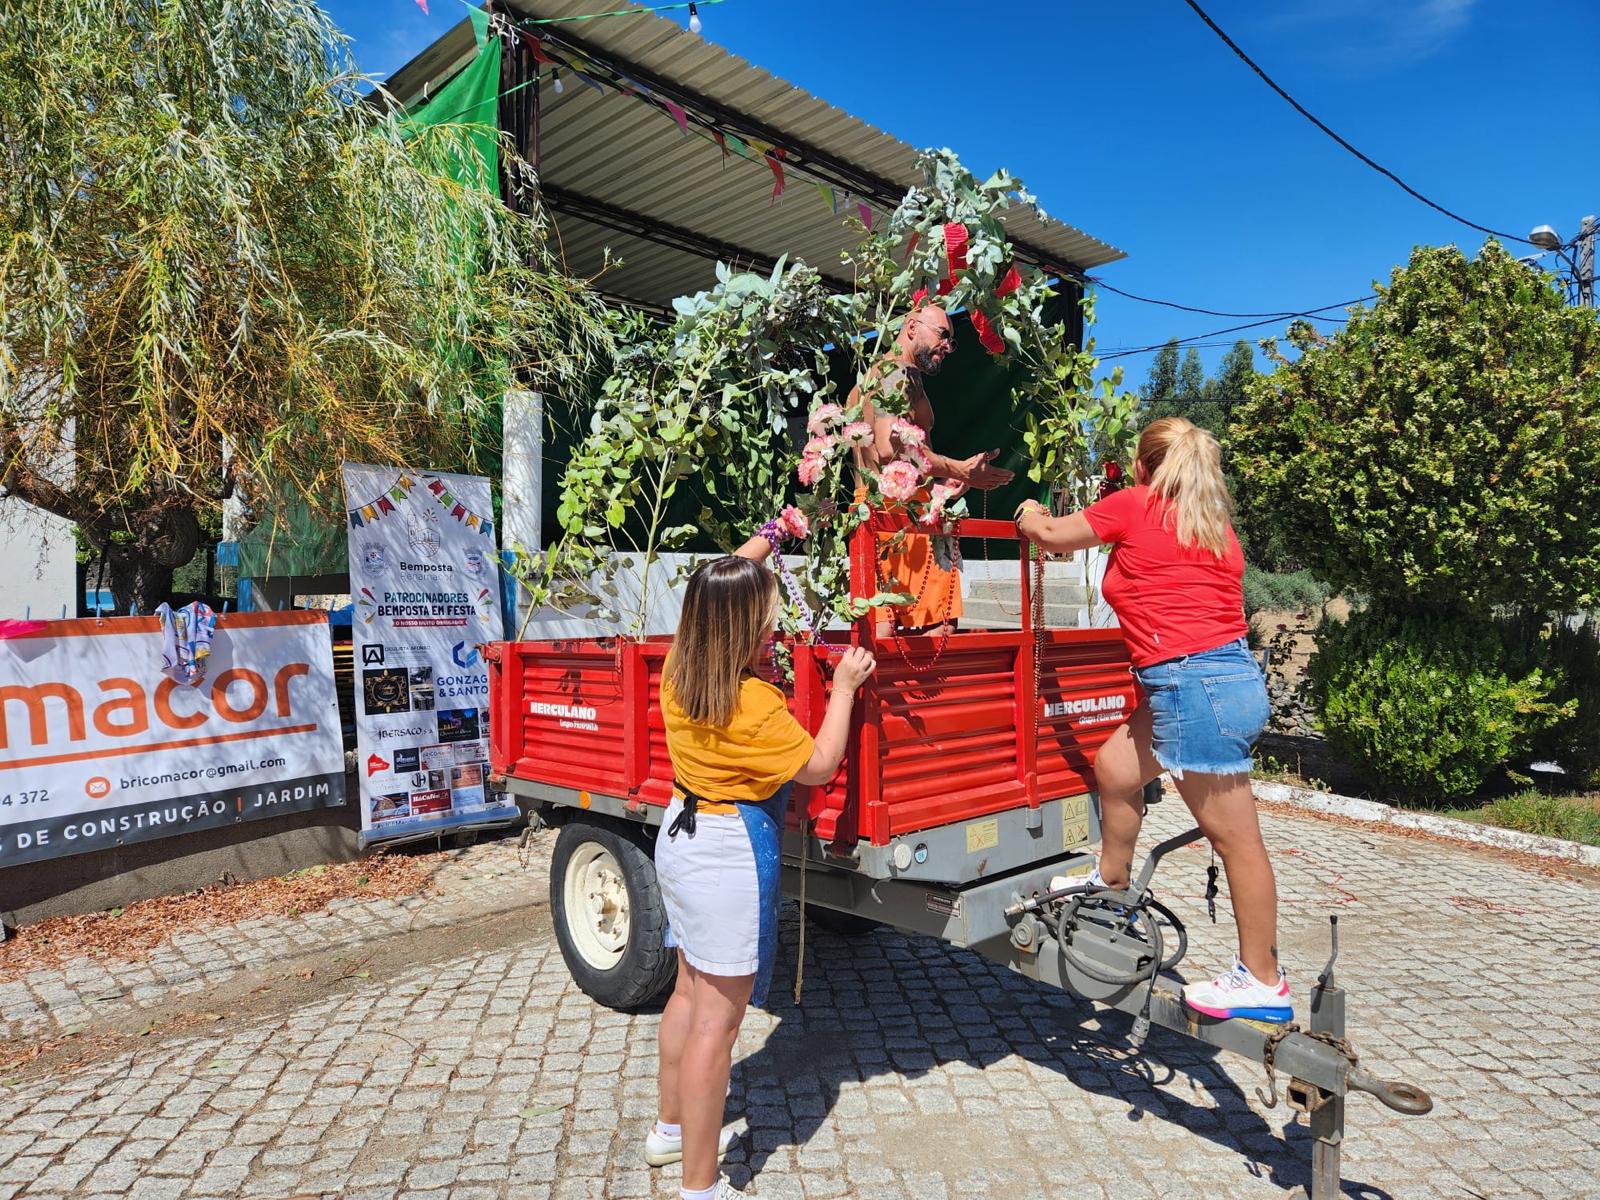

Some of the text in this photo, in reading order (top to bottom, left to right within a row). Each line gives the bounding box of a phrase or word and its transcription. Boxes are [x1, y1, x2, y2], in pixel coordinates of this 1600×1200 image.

[400, 561, 453, 573] Bemposta
[384, 592, 469, 603] PATROCINADORES
[377, 605, 477, 617] BEMPOSTA EM FESTA
[439, 688, 447, 698] &
[530, 701, 597, 721] HERCULANO
[1044, 694, 1126, 718] HERCULANO
[119, 756, 286, 790] bricomacor@gmail.com
[19, 789, 50, 805] 372
[17, 783, 329, 849] DE CONSTRUÇÃO JARDIM
